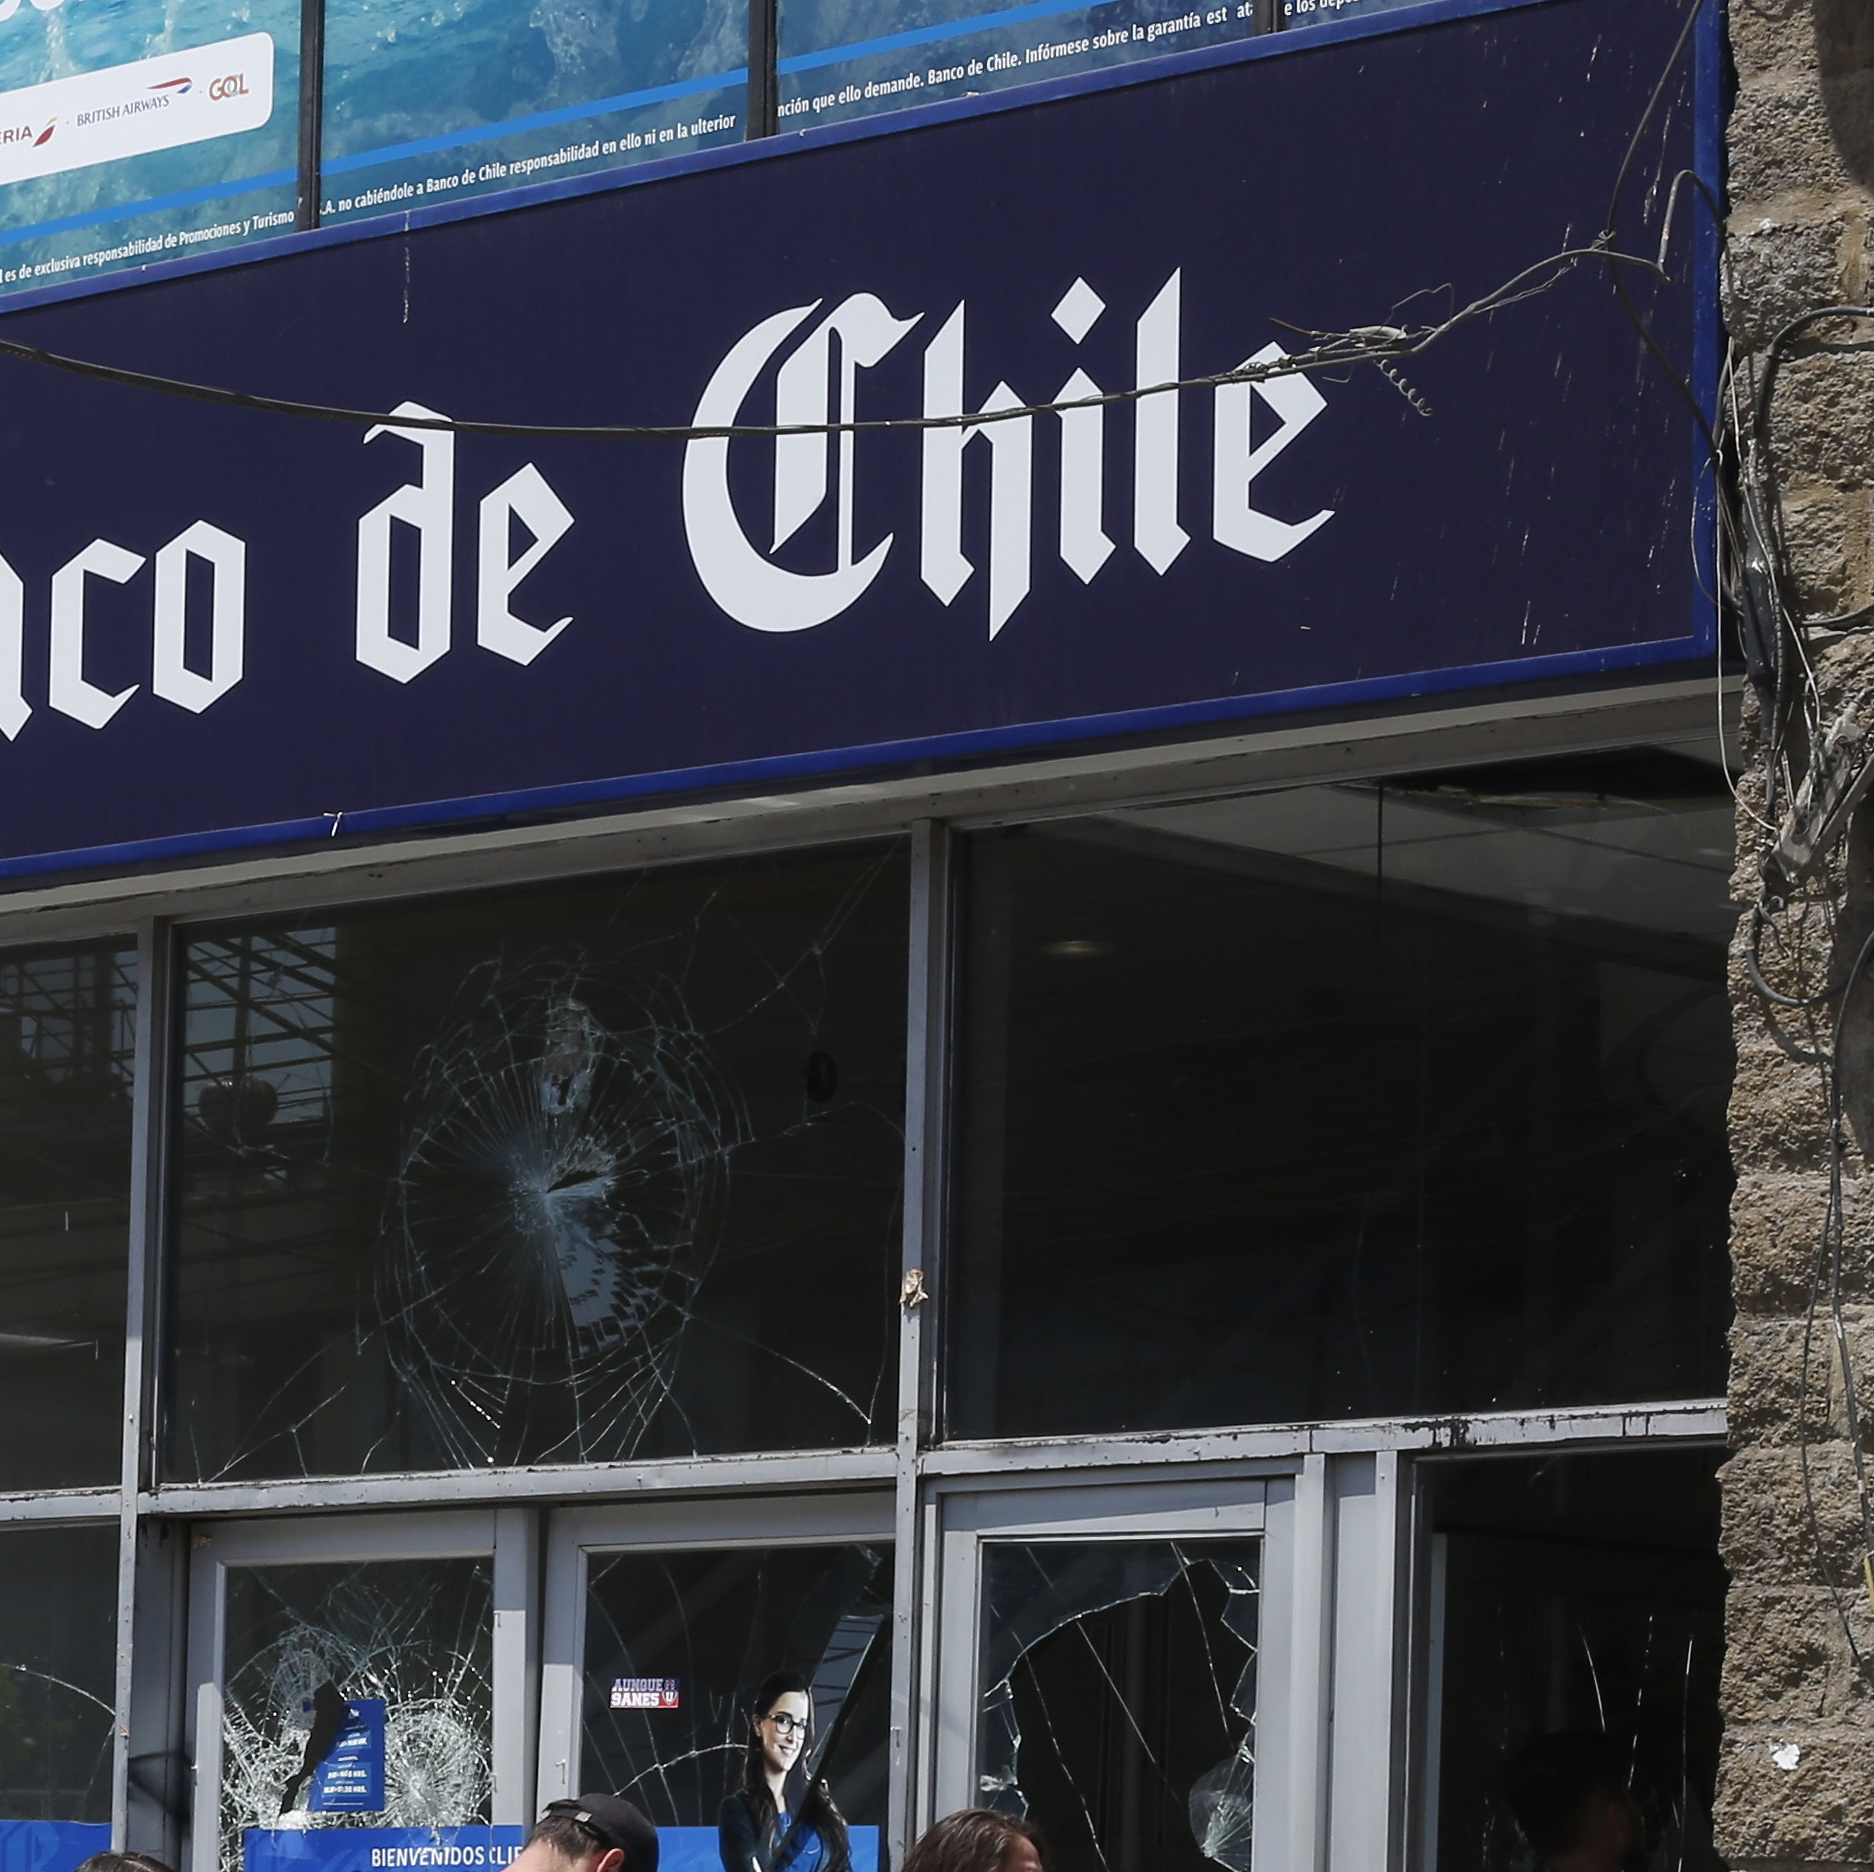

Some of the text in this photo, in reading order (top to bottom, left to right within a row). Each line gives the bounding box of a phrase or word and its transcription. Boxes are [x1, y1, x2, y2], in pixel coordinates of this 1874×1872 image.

[4, 267, 17, 283] es
[18, 262, 33, 278] de
[34, 253, 80, 276] exclusiva
[82, 236, 163, 267] responsabilidad
[164, 232, 178, 249] de
[179, 218, 241, 246] Promociones
[242, 218, 251, 237] y
[252, 209, 295, 231] Turismo
[338, 197, 352, 212] no
[354, 182, 415, 209] cabiéndole
[416, 182, 424, 196] a
[426, 173, 459, 194] Banco
[461, 167, 476, 185] de
[478, 160, 507, 182] Chile
[509, 140, 600, 175] responsabilidad
[602, 138, 617, 154] en
[619, 130, 641, 150] ello
[644, 127, 657, 145] ni
[659, 126, 674, 143] en
[677, 121, 688, 140] la
[690, 113, 736, 137] ulterior
[777, 92, 810, 118] nción
[812, 93, 836, 114] que
[838, 85, 861, 105] ello
[864, 73, 925, 98] demande.
[928, 65, 965, 86] Banco
[967, 59, 983, 76] de
[986, 51, 1022, 73] Chile.
[1025, 38, 1089, 64] Infórmese
[1092, 29, 1129, 49] sobre
[1132, 24, 1144, 41] la
[1147, 11, 1201, 43] garantía
[76, 105, 120, 127] BRITISH
[122, 94, 170, 118] AIRWAYS
[355, 401, 575, 683] de
[682, 267, 1336, 642] Chile
[371, 1846, 485, 1868] BIENVENIDOS
